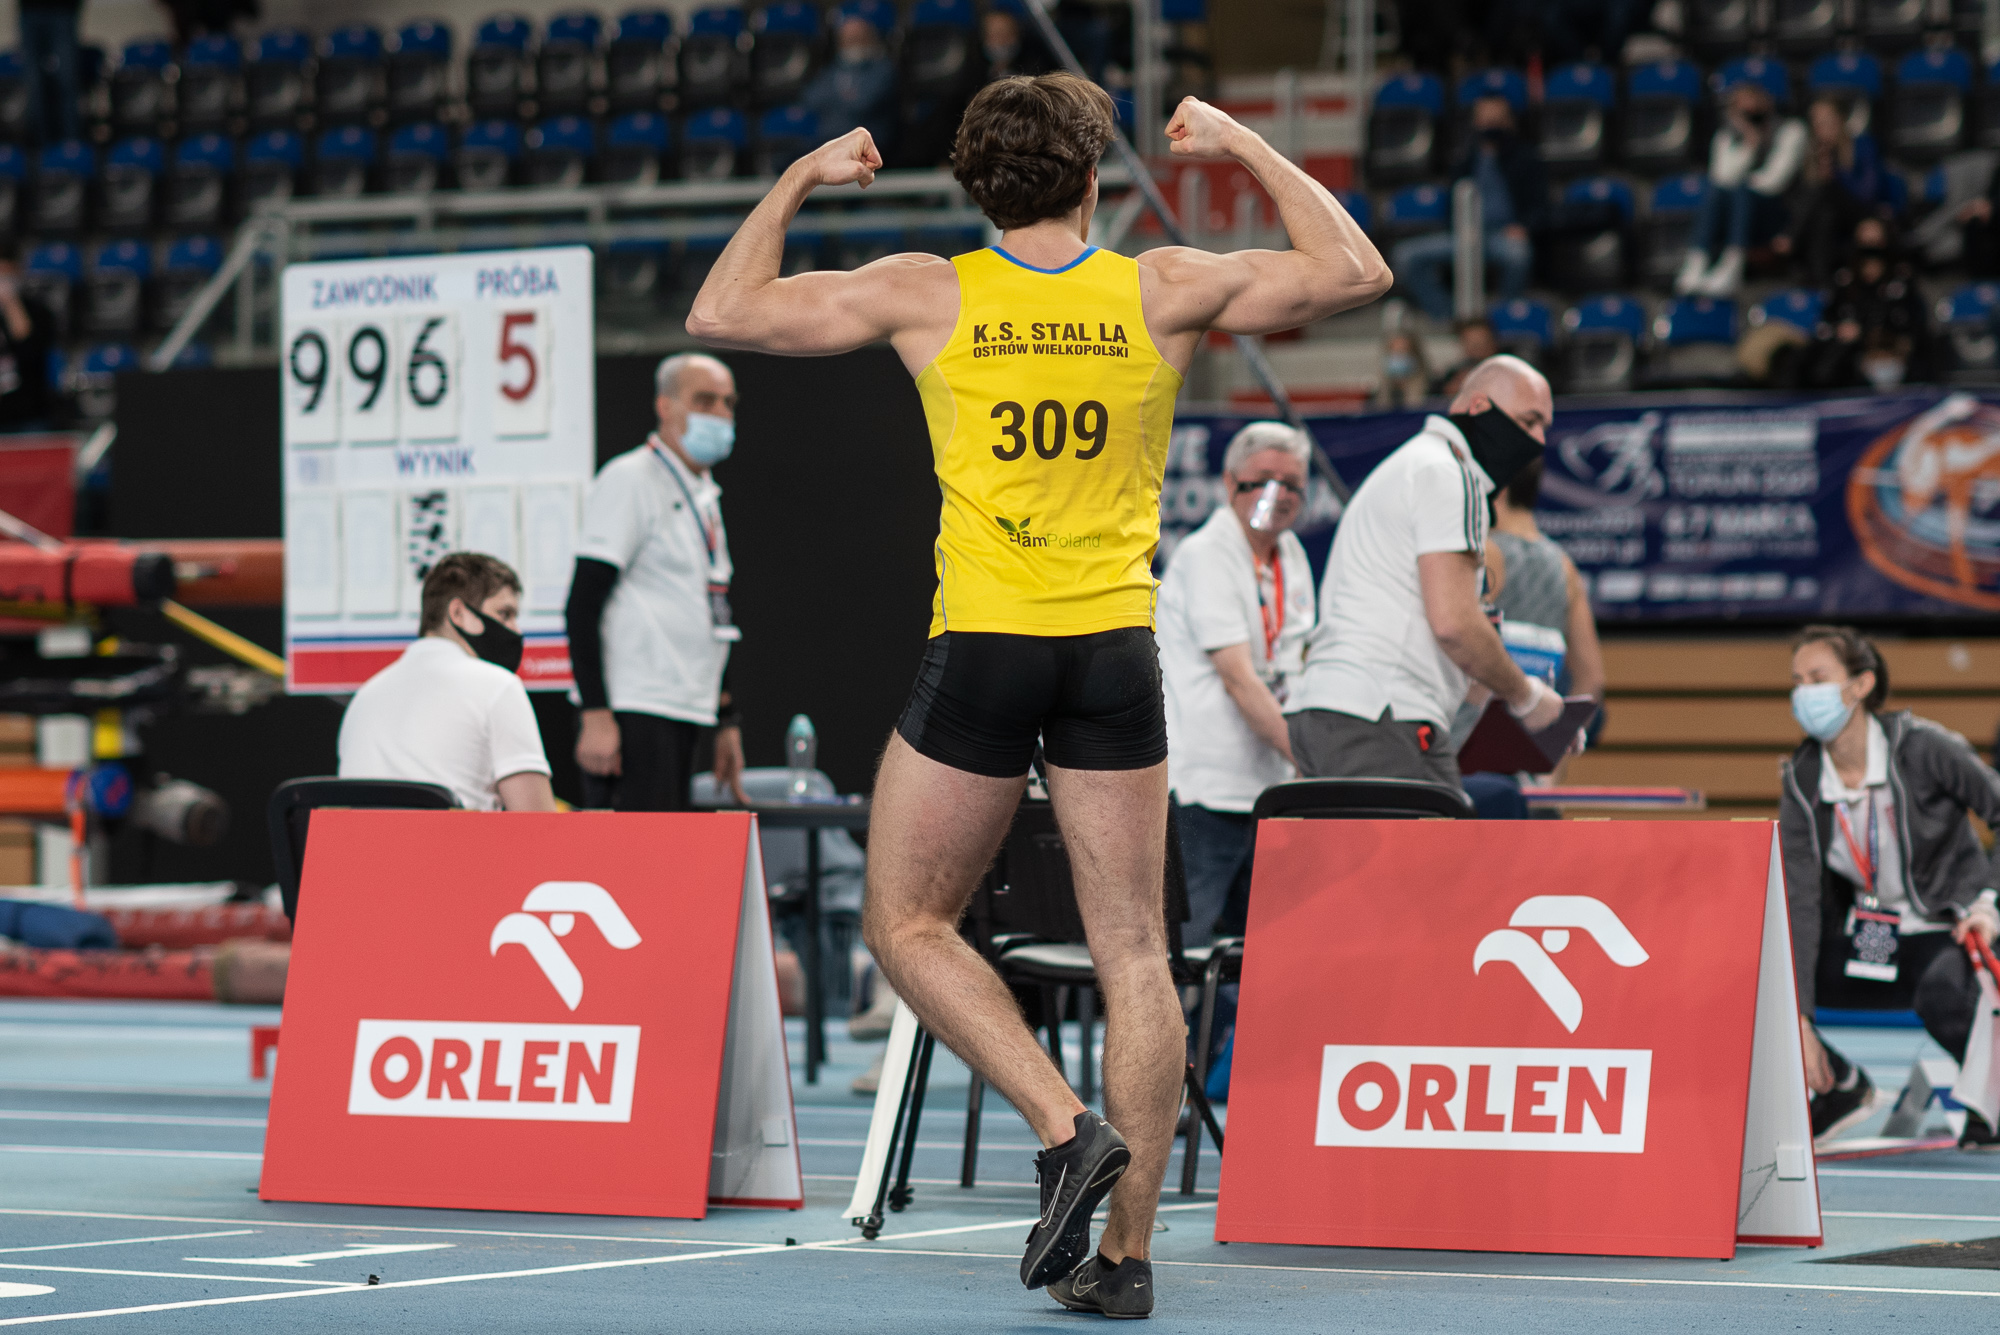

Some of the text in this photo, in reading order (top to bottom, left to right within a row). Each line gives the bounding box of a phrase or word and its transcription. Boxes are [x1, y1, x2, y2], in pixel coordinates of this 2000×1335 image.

[312, 264, 560, 310] ZAWODNIK PRÓBA
[498, 310, 539, 404] 5
[973, 321, 1128, 344] K.S. STAL LA
[973, 341, 1129, 359] OSTRÓW WIELKOPOLSKI
[990, 398, 1109, 462] 309
[395, 446, 477, 478] WYNIK
[369, 1035, 619, 1106] ORLEN
[1336, 1060, 1628, 1136] ORLEN
